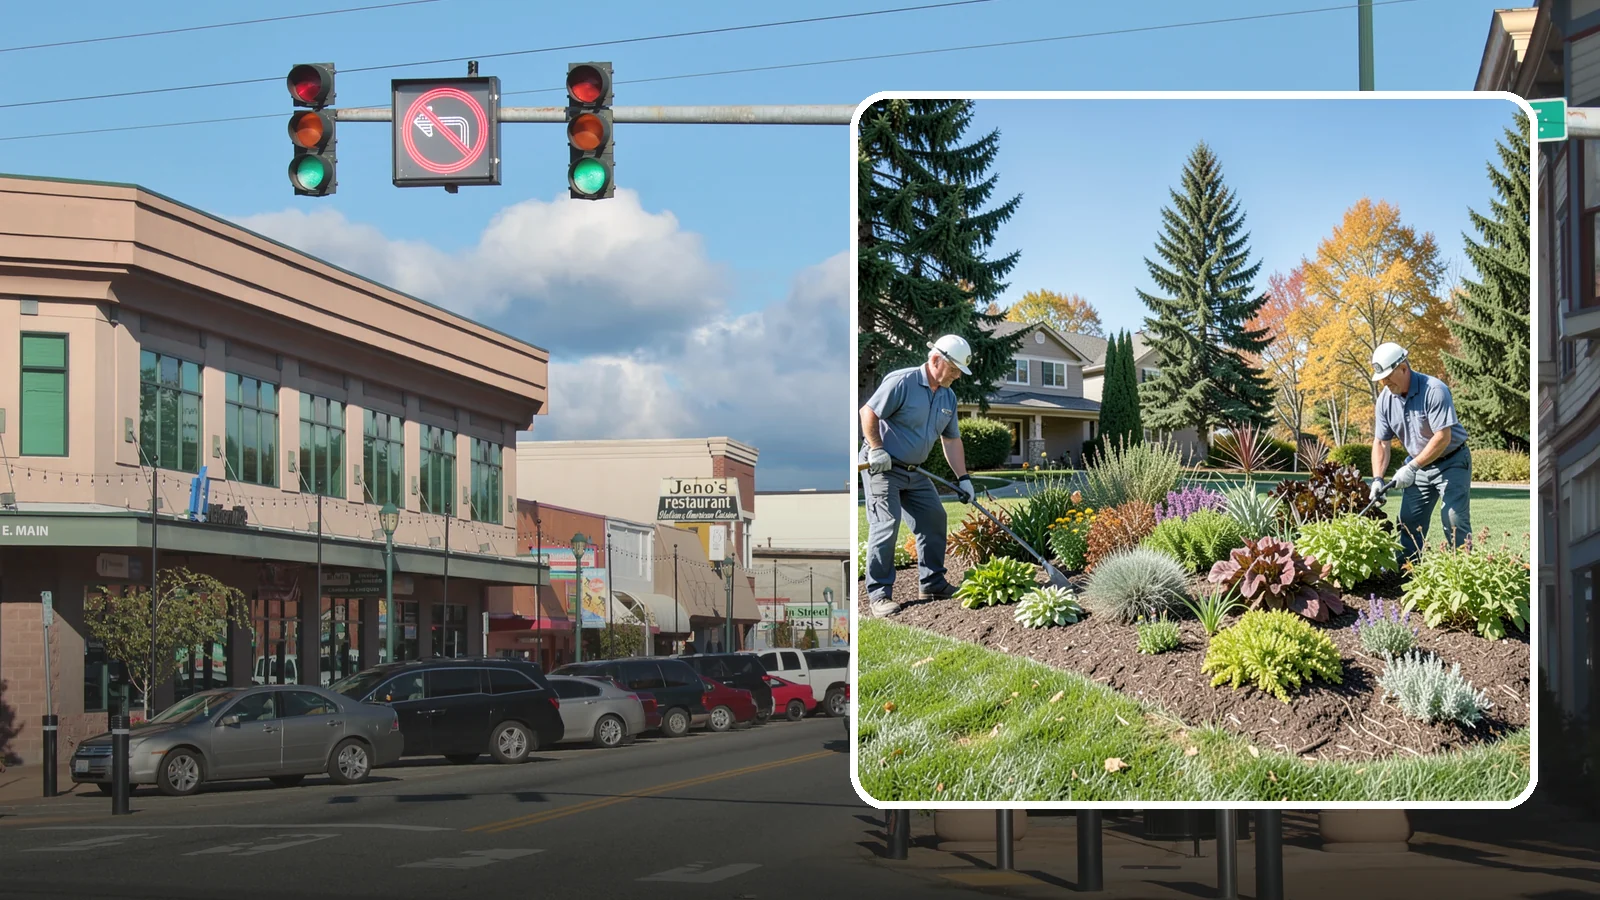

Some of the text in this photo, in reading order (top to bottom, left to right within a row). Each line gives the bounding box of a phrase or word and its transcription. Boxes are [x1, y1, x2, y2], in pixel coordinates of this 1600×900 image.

[669, 480, 728, 494] Jeno's
[665, 496, 731, 509] restaurant
[658, 510, 682, 519] Italian
[686, 509, 715, 519] American
[714, 509, 738, 519] Cuisine
[2, 525, 49, 536] E. MAIN
[785, 607, 795, 617] in
[797, 607, 828, 617] Street
[790, 619, 824, 627] lass
